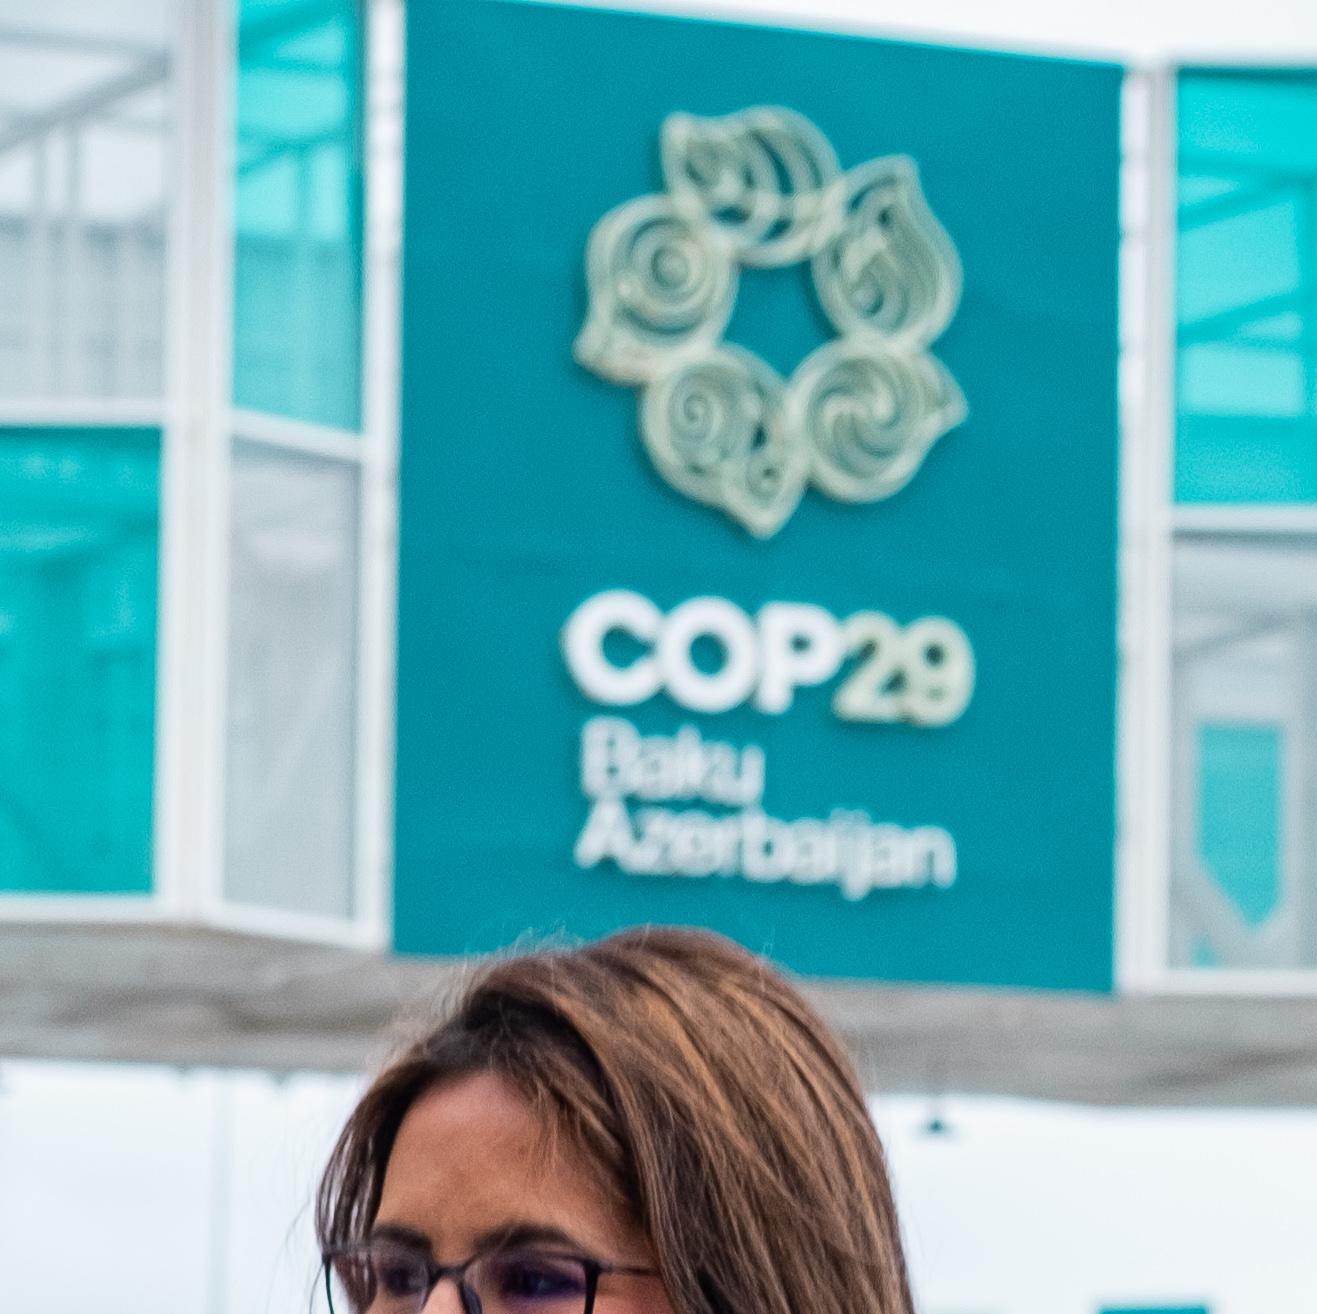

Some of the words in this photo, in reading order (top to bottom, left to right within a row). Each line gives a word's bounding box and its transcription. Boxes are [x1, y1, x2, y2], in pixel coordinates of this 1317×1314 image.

[560, 588, 977, 728] COP29
[581, 716, 765, 806] Baku
[574, 795, 957, 901] Azerbaijan
